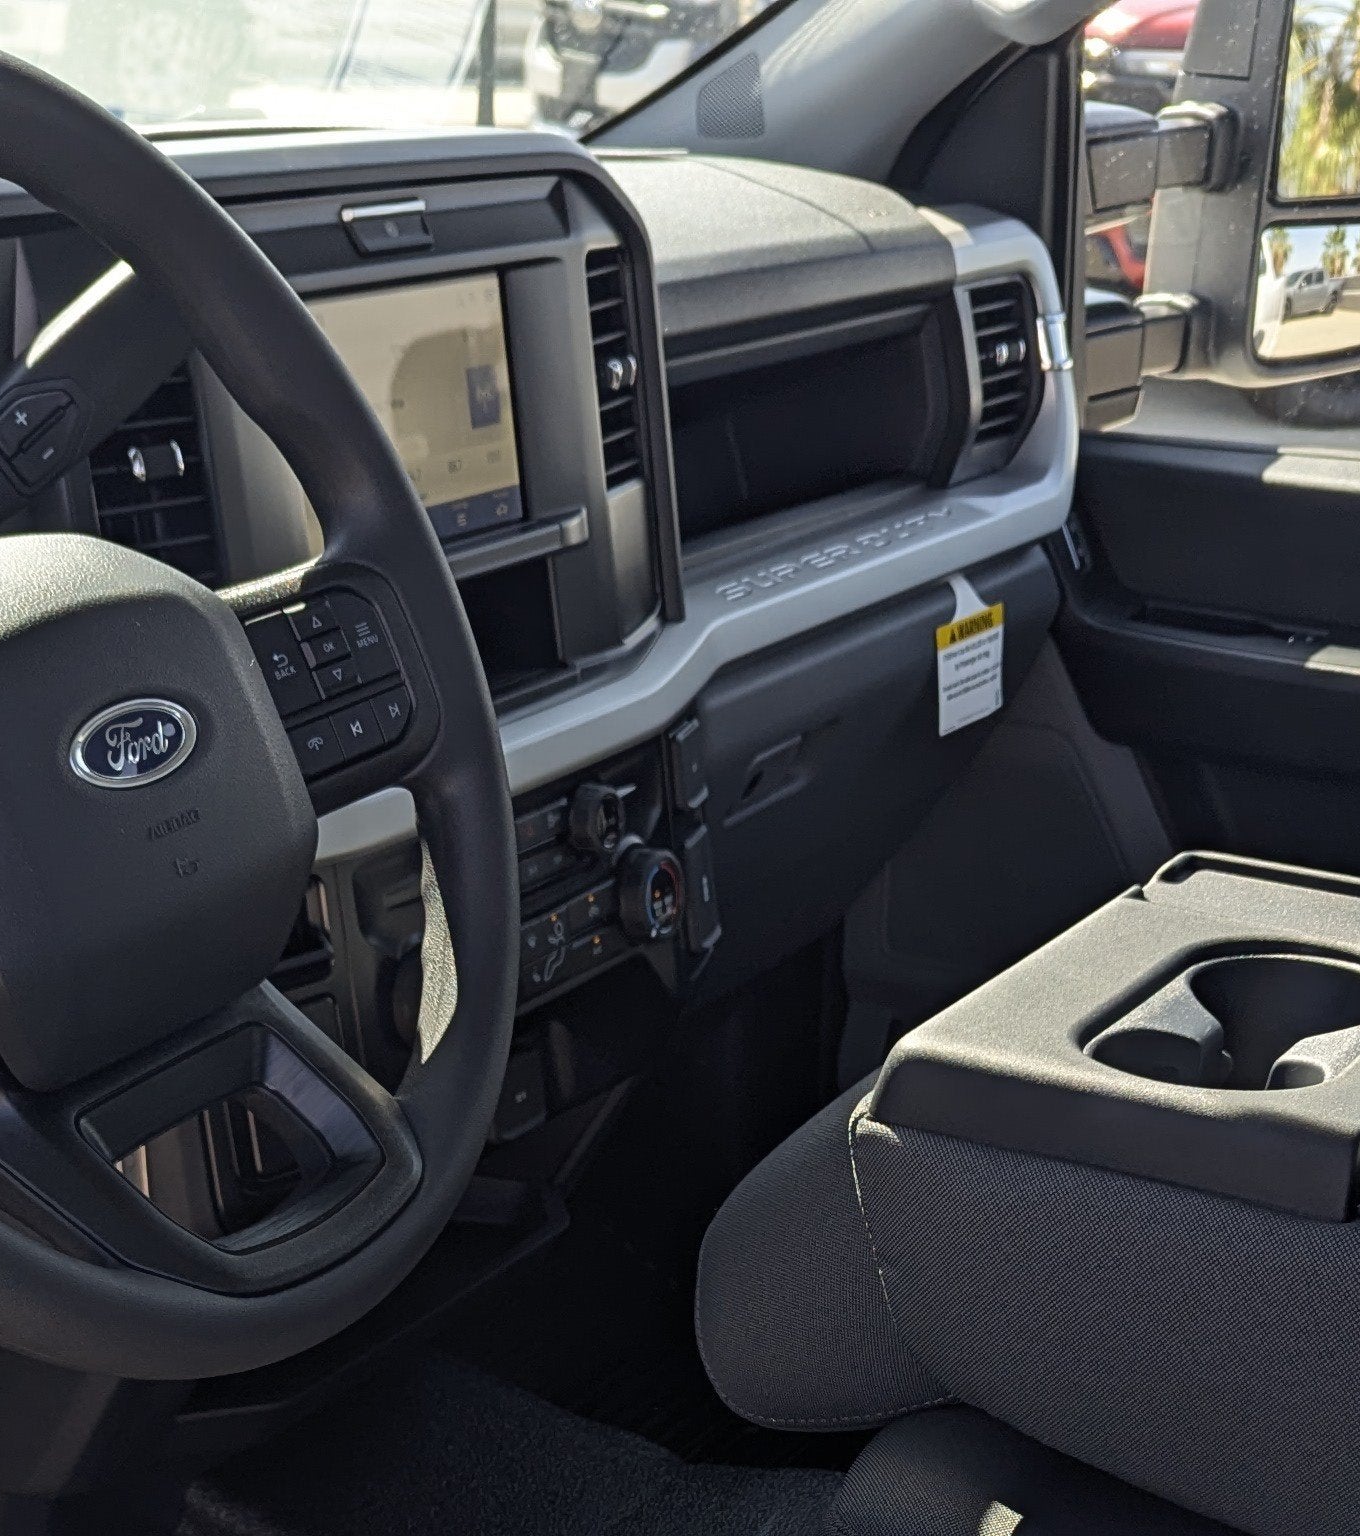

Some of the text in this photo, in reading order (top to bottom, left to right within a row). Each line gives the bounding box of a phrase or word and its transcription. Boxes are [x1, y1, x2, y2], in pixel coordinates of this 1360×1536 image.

[715, 543, 862, 601] SUPER
[323, 642, 335, 653] OK
[356, 634, 379, 648] MENU
[274, 666, 297, 681] BACK
[105, 717, 169, 771] Ford
